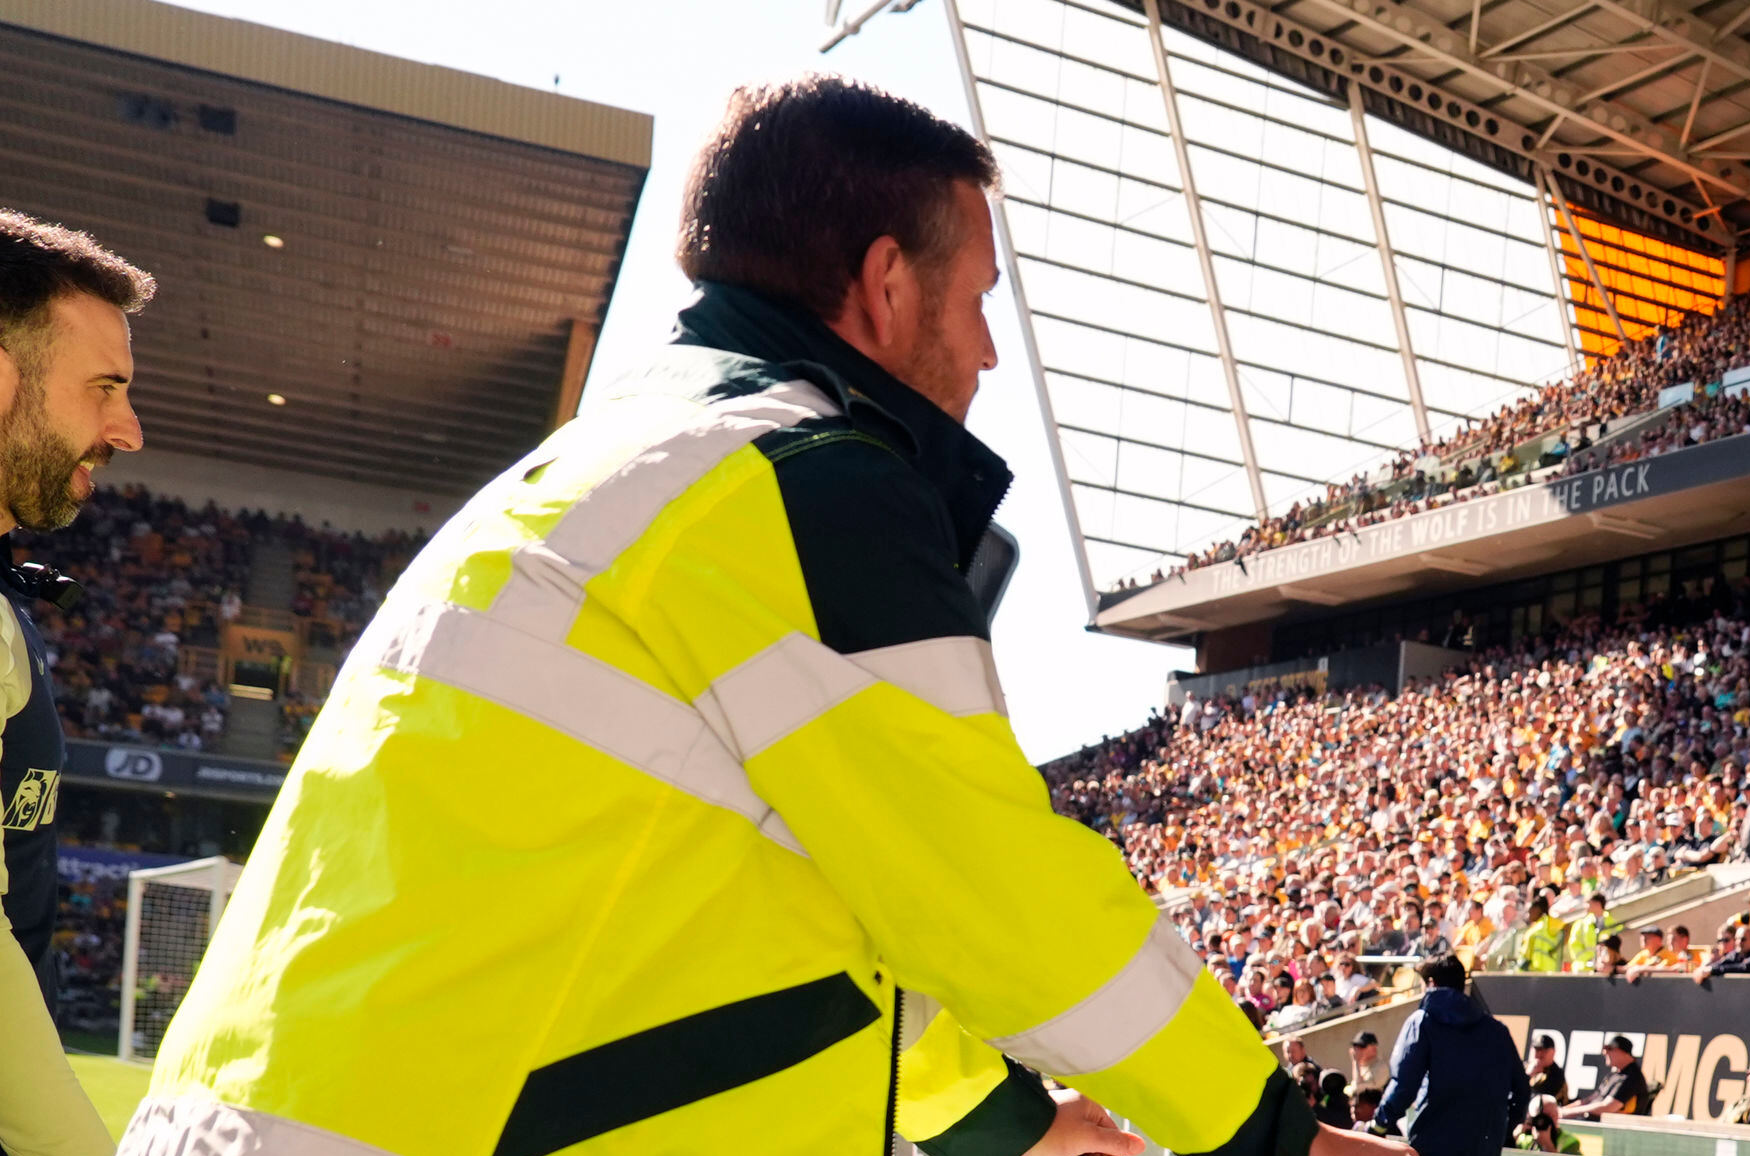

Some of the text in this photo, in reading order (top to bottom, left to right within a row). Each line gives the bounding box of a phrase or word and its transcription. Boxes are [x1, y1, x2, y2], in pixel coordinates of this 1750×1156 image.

[1249, 542, 1331, 585] STRENGTH
[1370, 528, 1404, 557] THE
[1411, 508, 1468, 547] WOLF
[1477, 501, 1497, 532] IS
[1506, 492, 1532, 525] IN
[1541, 479, 1583, 518] THE
[1592, 462, 1651, 505] PACK
